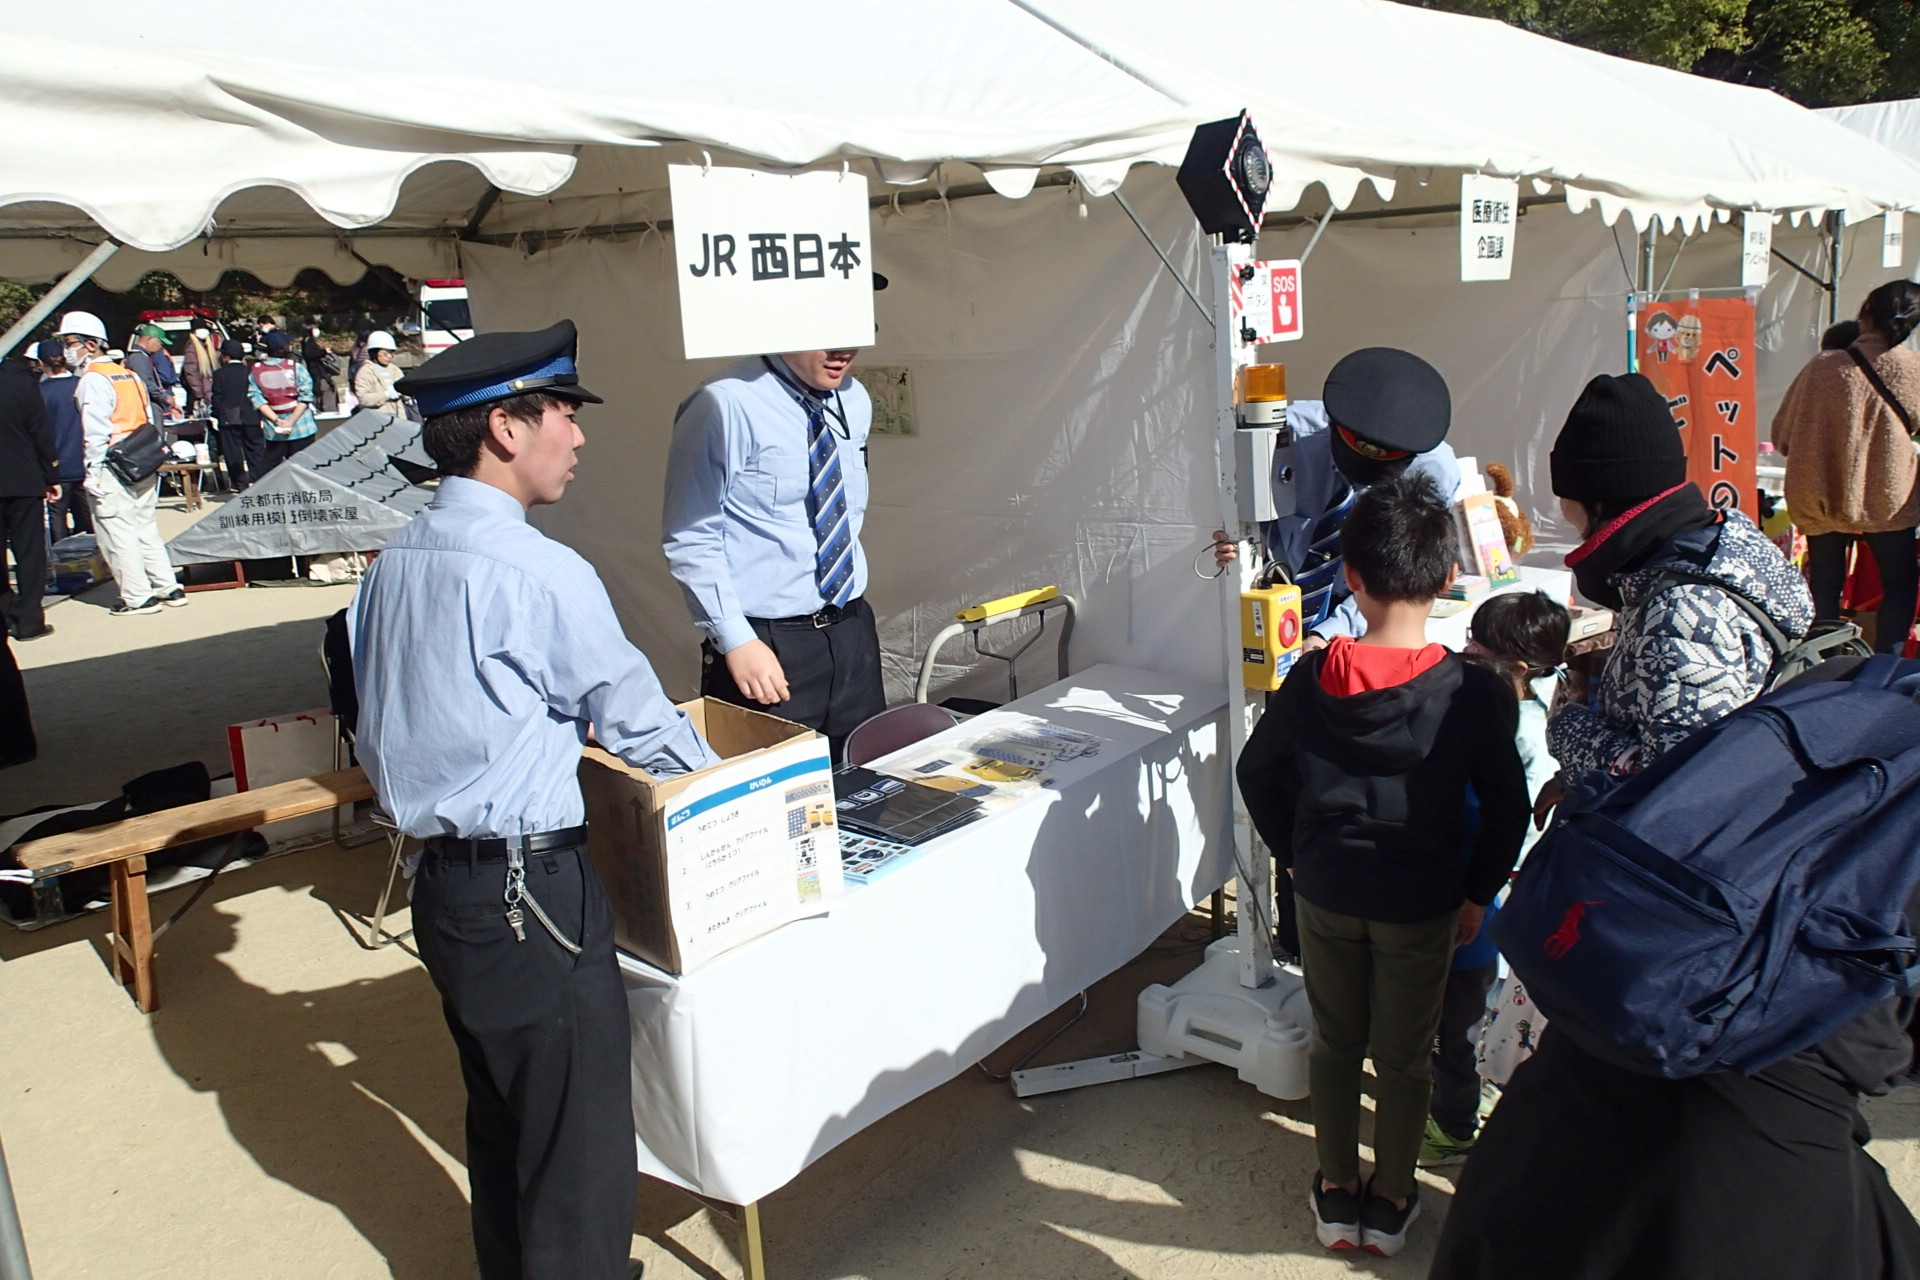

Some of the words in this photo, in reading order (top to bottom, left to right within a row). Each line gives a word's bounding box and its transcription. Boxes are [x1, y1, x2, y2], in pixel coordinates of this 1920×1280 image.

[689, 233, 737, 277] JR
[748, 232, 862, 281] 西日本
[1273, 275, 1295, 293] SOS
[1702, 348, 1742, 511] ペットの
[239, 489, 333, 509] 京都市消防局
[749, 776, 772, 791] けいひん
[735, 826, 769, 845] クリアファイル
[728, 869, 760, 888] クリアファイル
[734, 900, 768, 919] クリアファイル
